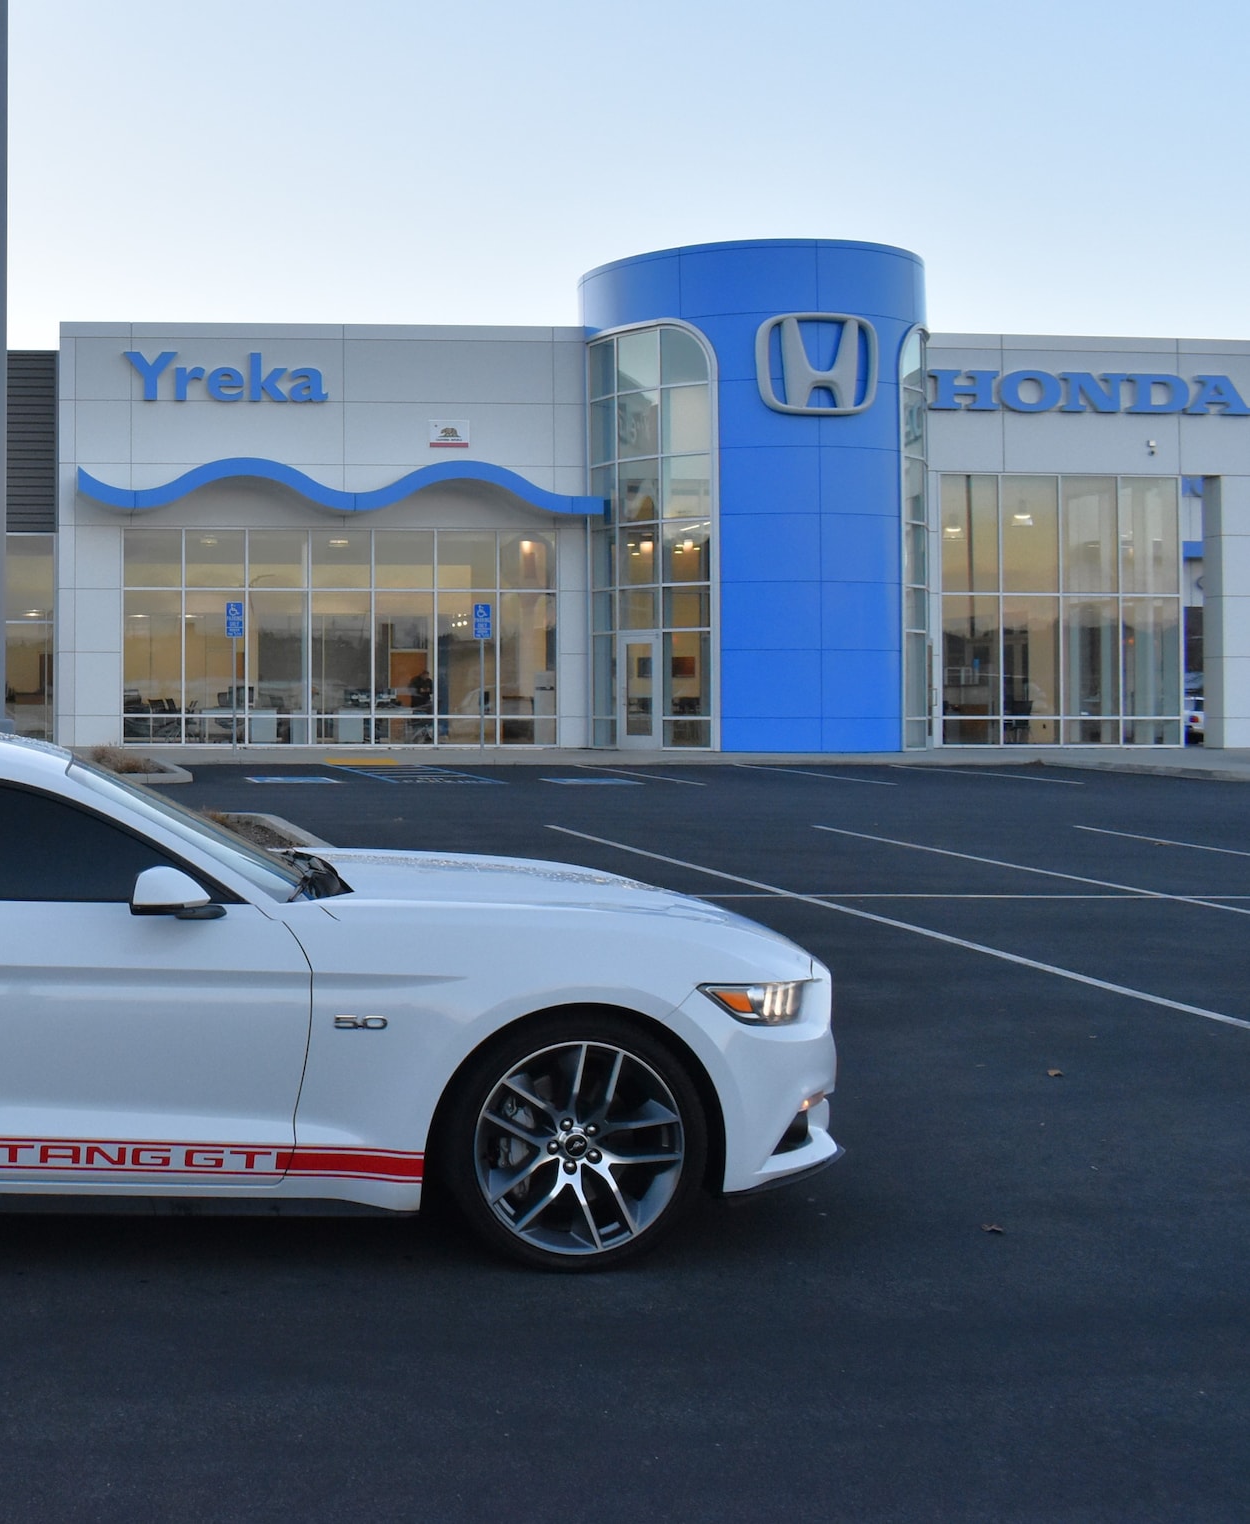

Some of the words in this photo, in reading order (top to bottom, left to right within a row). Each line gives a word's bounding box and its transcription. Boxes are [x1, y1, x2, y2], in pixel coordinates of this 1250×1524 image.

[124, 351, 328, 402] Yreka
[928, 369, 1250, 416] HONDA
[334, 1014, 388, 1029] 5.0
[184, 1149, 272, 1169] GT
